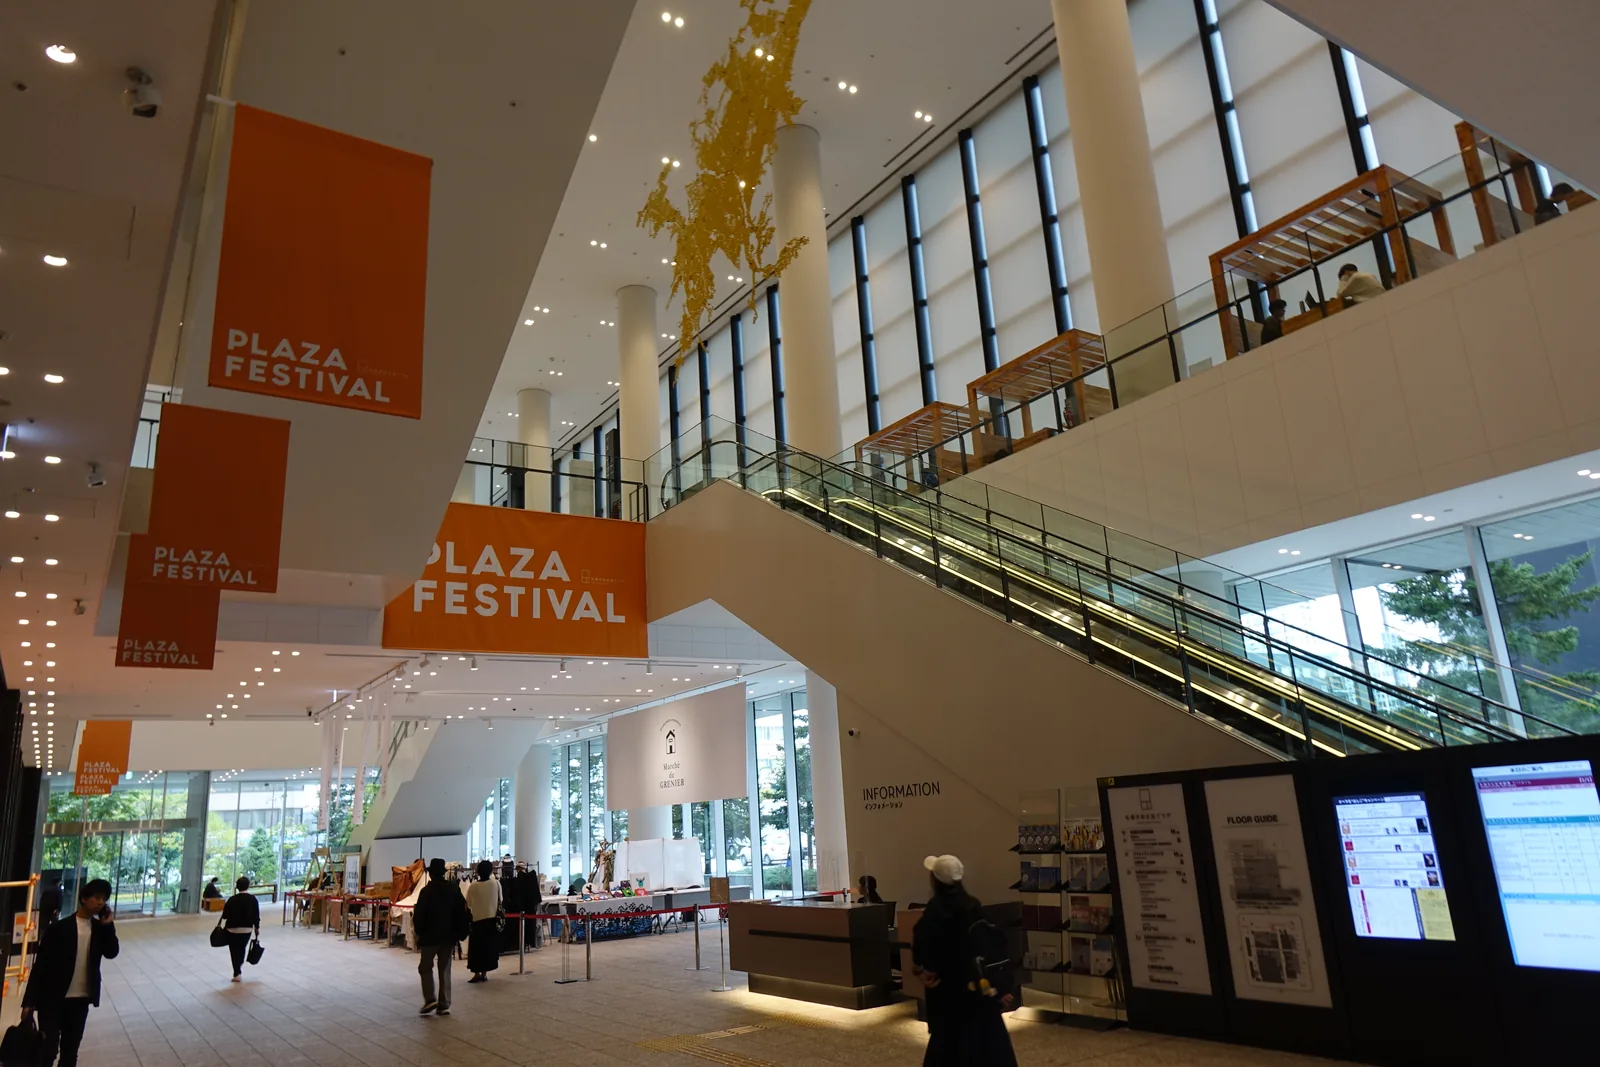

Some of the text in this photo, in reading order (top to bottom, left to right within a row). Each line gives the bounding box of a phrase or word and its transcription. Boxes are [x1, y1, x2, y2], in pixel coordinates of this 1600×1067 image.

[227, 328, 348, 370] PLAZA
[225, 355, 390, 403] FESTIVAL
[154, 546, 230, 566] PLAZA
[152, 563, 257, 585] FESTIVAL
[413, 579, 626, 623] FESTIVAL
[124, 639, 179, 652] PLAZA
[122, 652, 199, 664] FESTIVAL
[659, 778, 685, 789] GRENIER
[863, 781, 940, 801] INFORMATION
[864, 801, 903, 810] インフォメーション
[1227, 814, 1278, 824] FLOOR GUIDE
